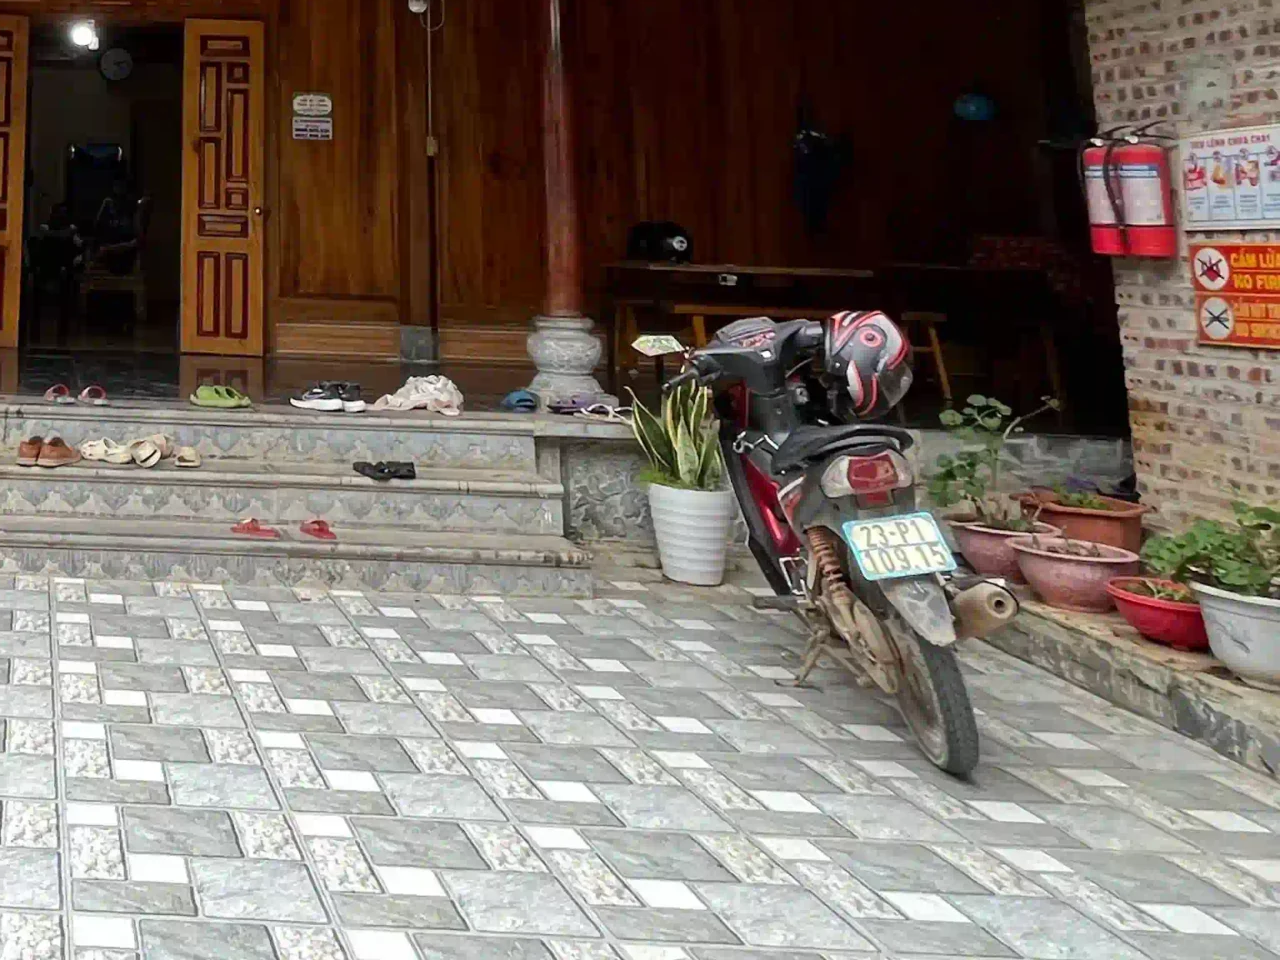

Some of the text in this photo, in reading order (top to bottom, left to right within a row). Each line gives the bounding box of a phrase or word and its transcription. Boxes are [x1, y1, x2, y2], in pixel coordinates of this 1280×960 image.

[1233, 274, 1280, 290] NO FIR
[860, 520, 925, 548] 23-P1
[865, 541, 946, 573] 109.15
